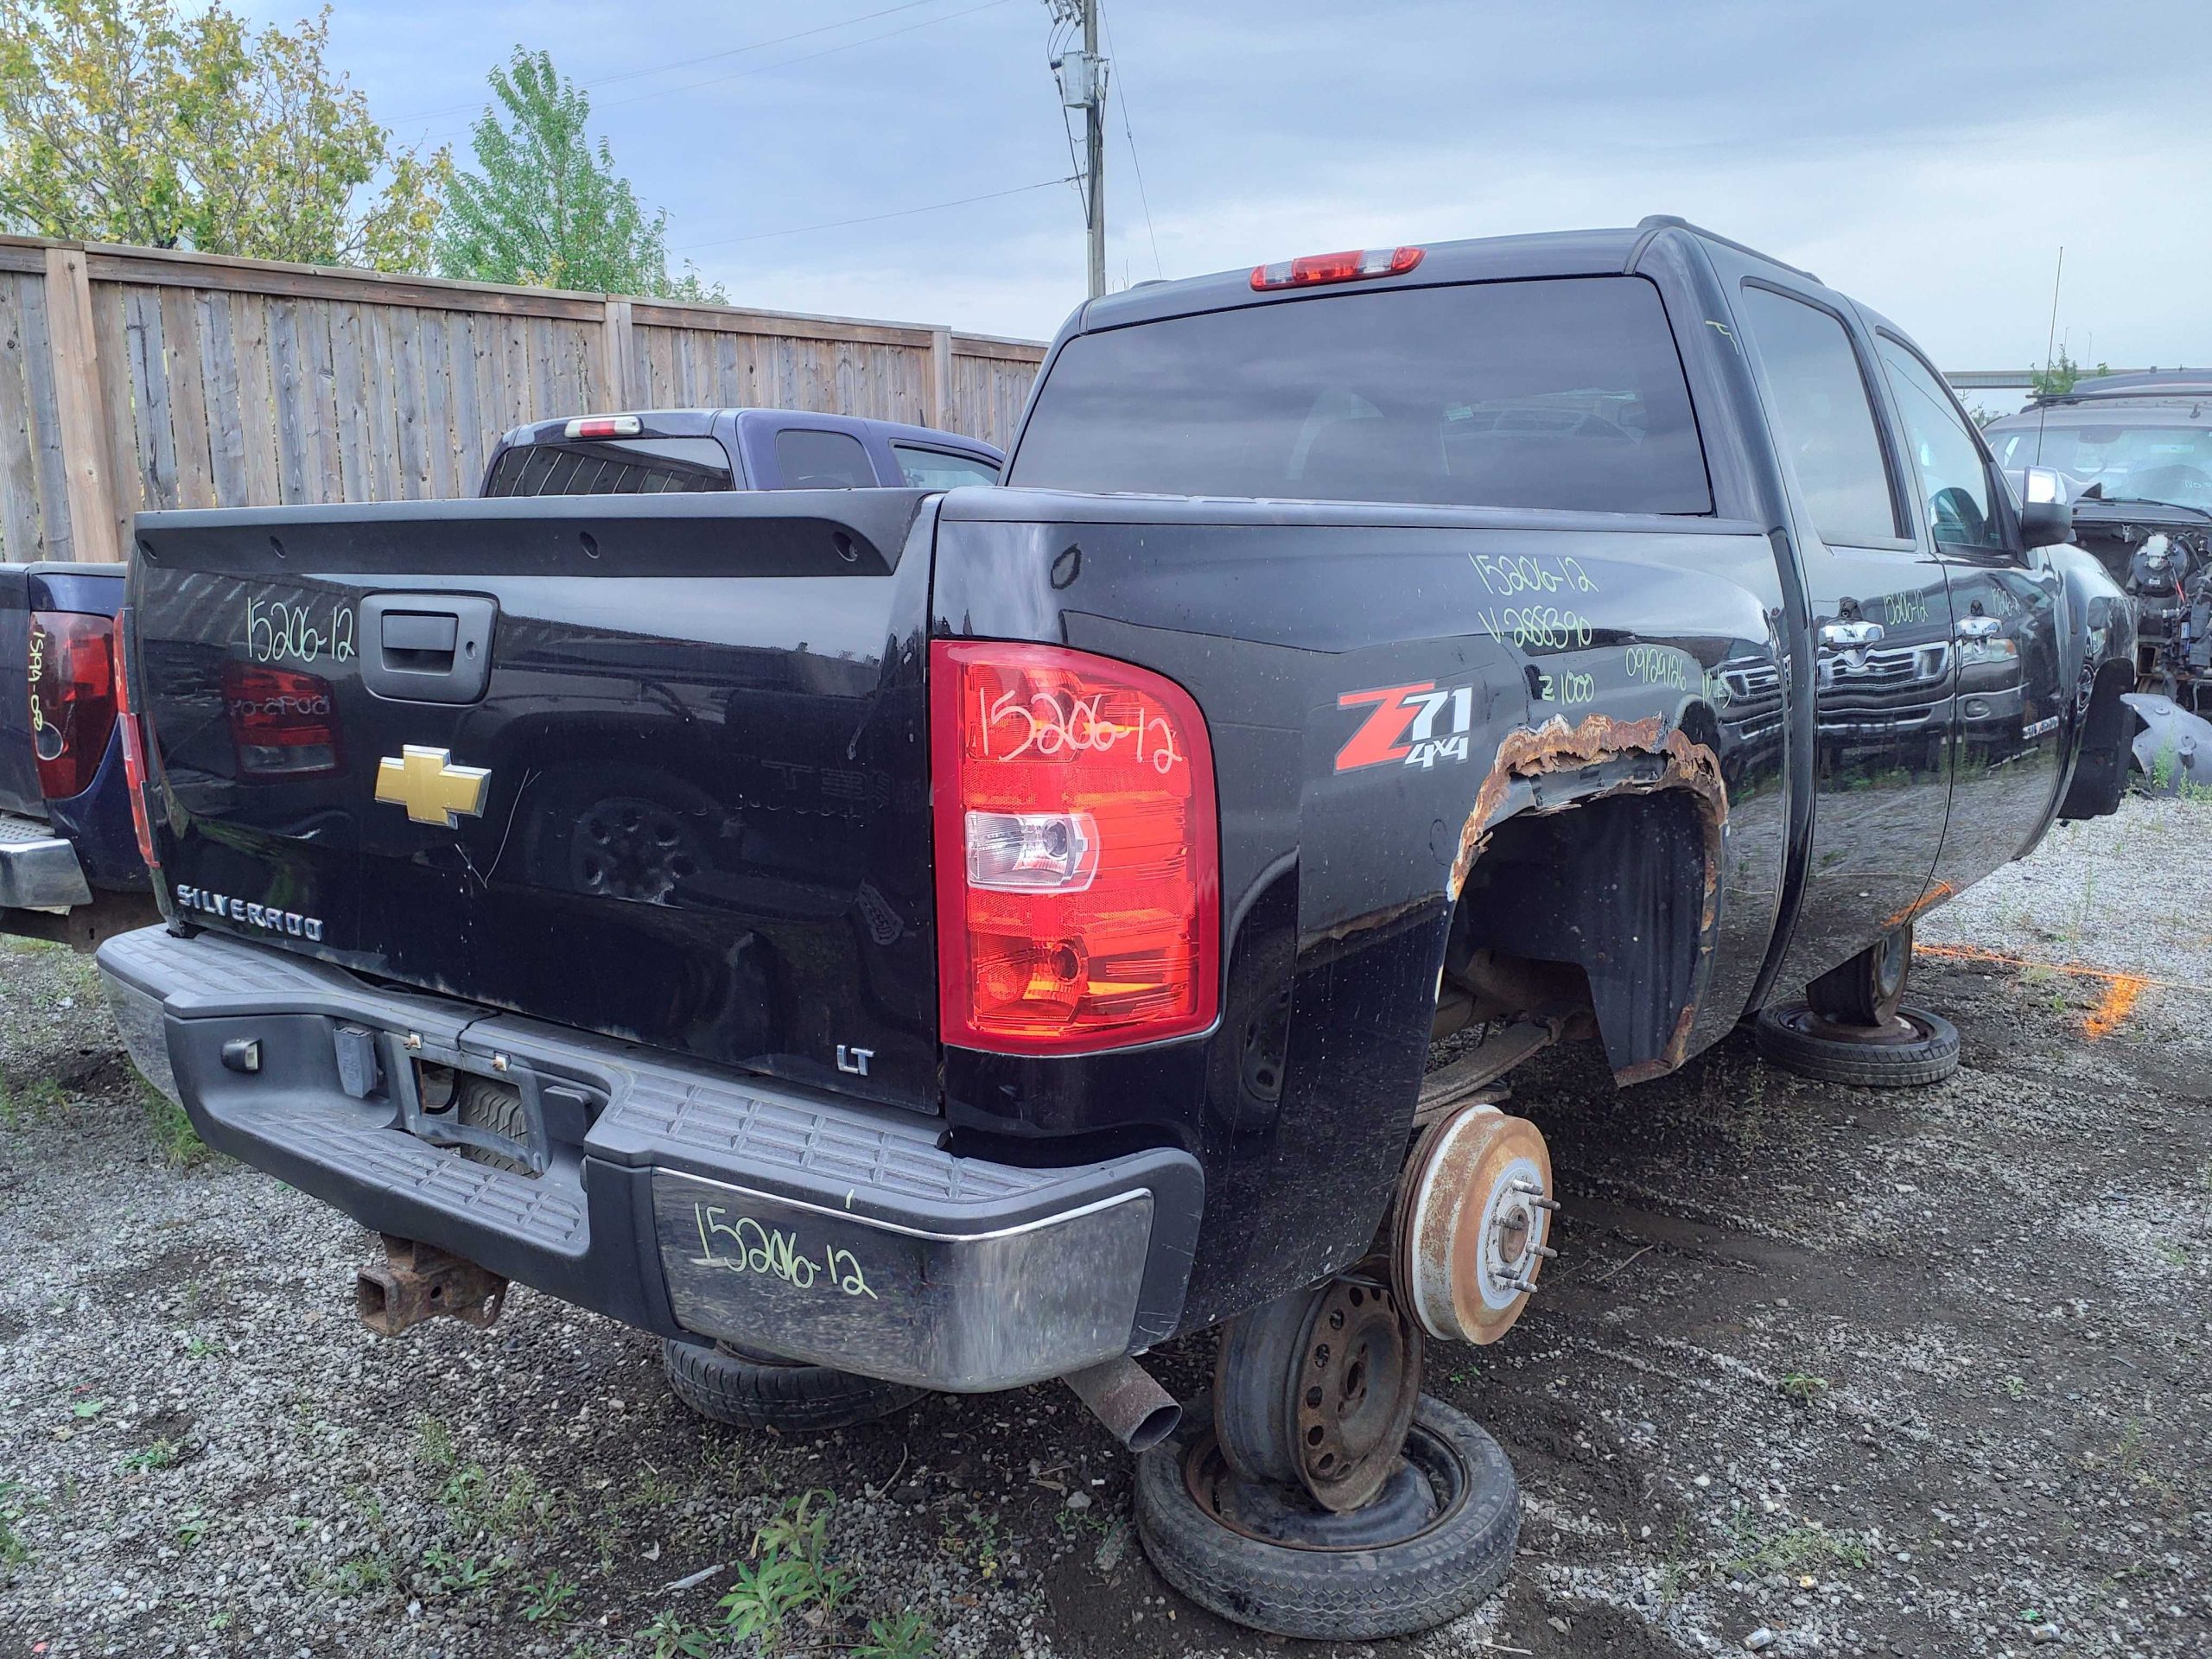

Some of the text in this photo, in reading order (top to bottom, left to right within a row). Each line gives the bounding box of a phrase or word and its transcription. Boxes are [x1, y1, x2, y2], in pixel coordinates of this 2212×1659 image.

[1468, 552, 1599, 596] 15206-12
[247, 596, 355, 663] 15206-12
[980, 687, 1183, 774] 15206-12
[1335, 682, 1472, 771] Z71
[177, 884, 324, 942] SILVERADO
[836, 1045, 875, 1077] LT
[694, 1202, 879, 1300] 15206-12
